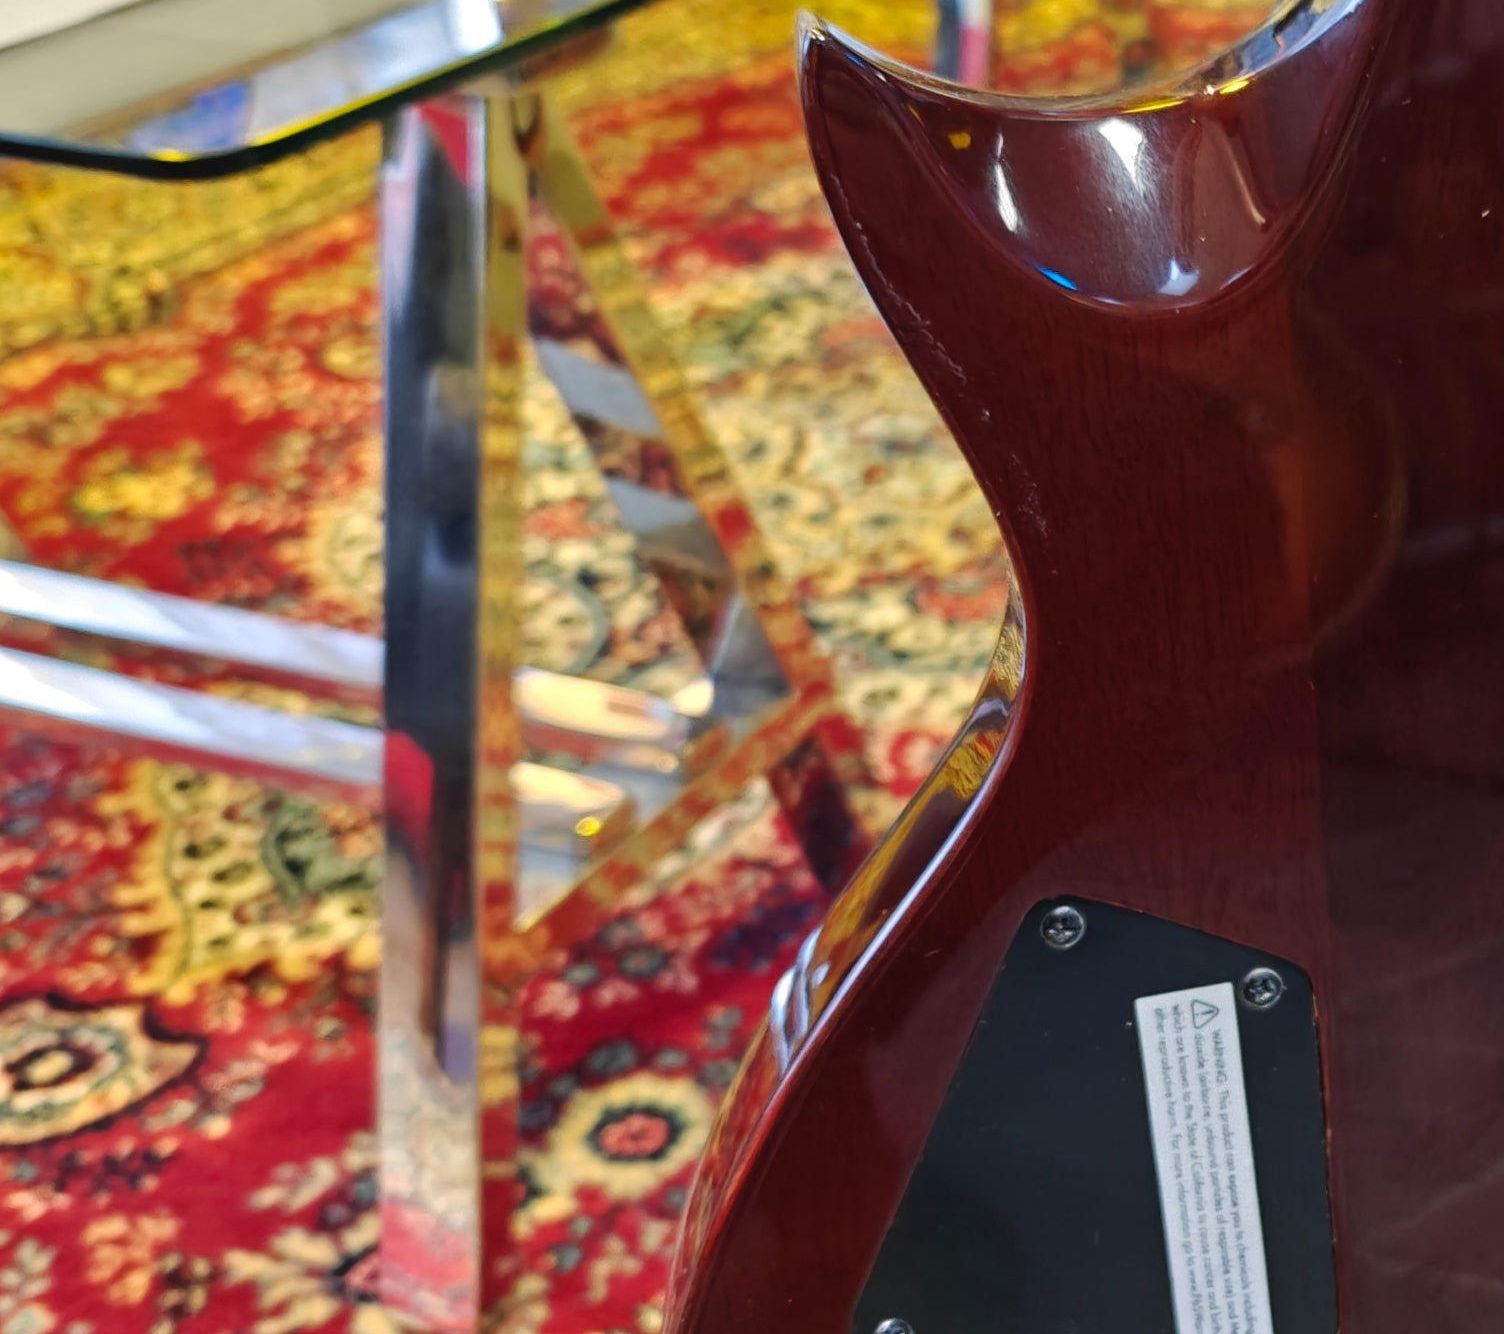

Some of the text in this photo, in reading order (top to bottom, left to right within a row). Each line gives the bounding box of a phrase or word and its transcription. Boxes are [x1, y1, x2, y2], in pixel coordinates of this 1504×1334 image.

[1220, 1111, 1234, 1151] product
[1192, 1161, 1206, 1211] California
[1226, 1173, 1237, 1207] expose
